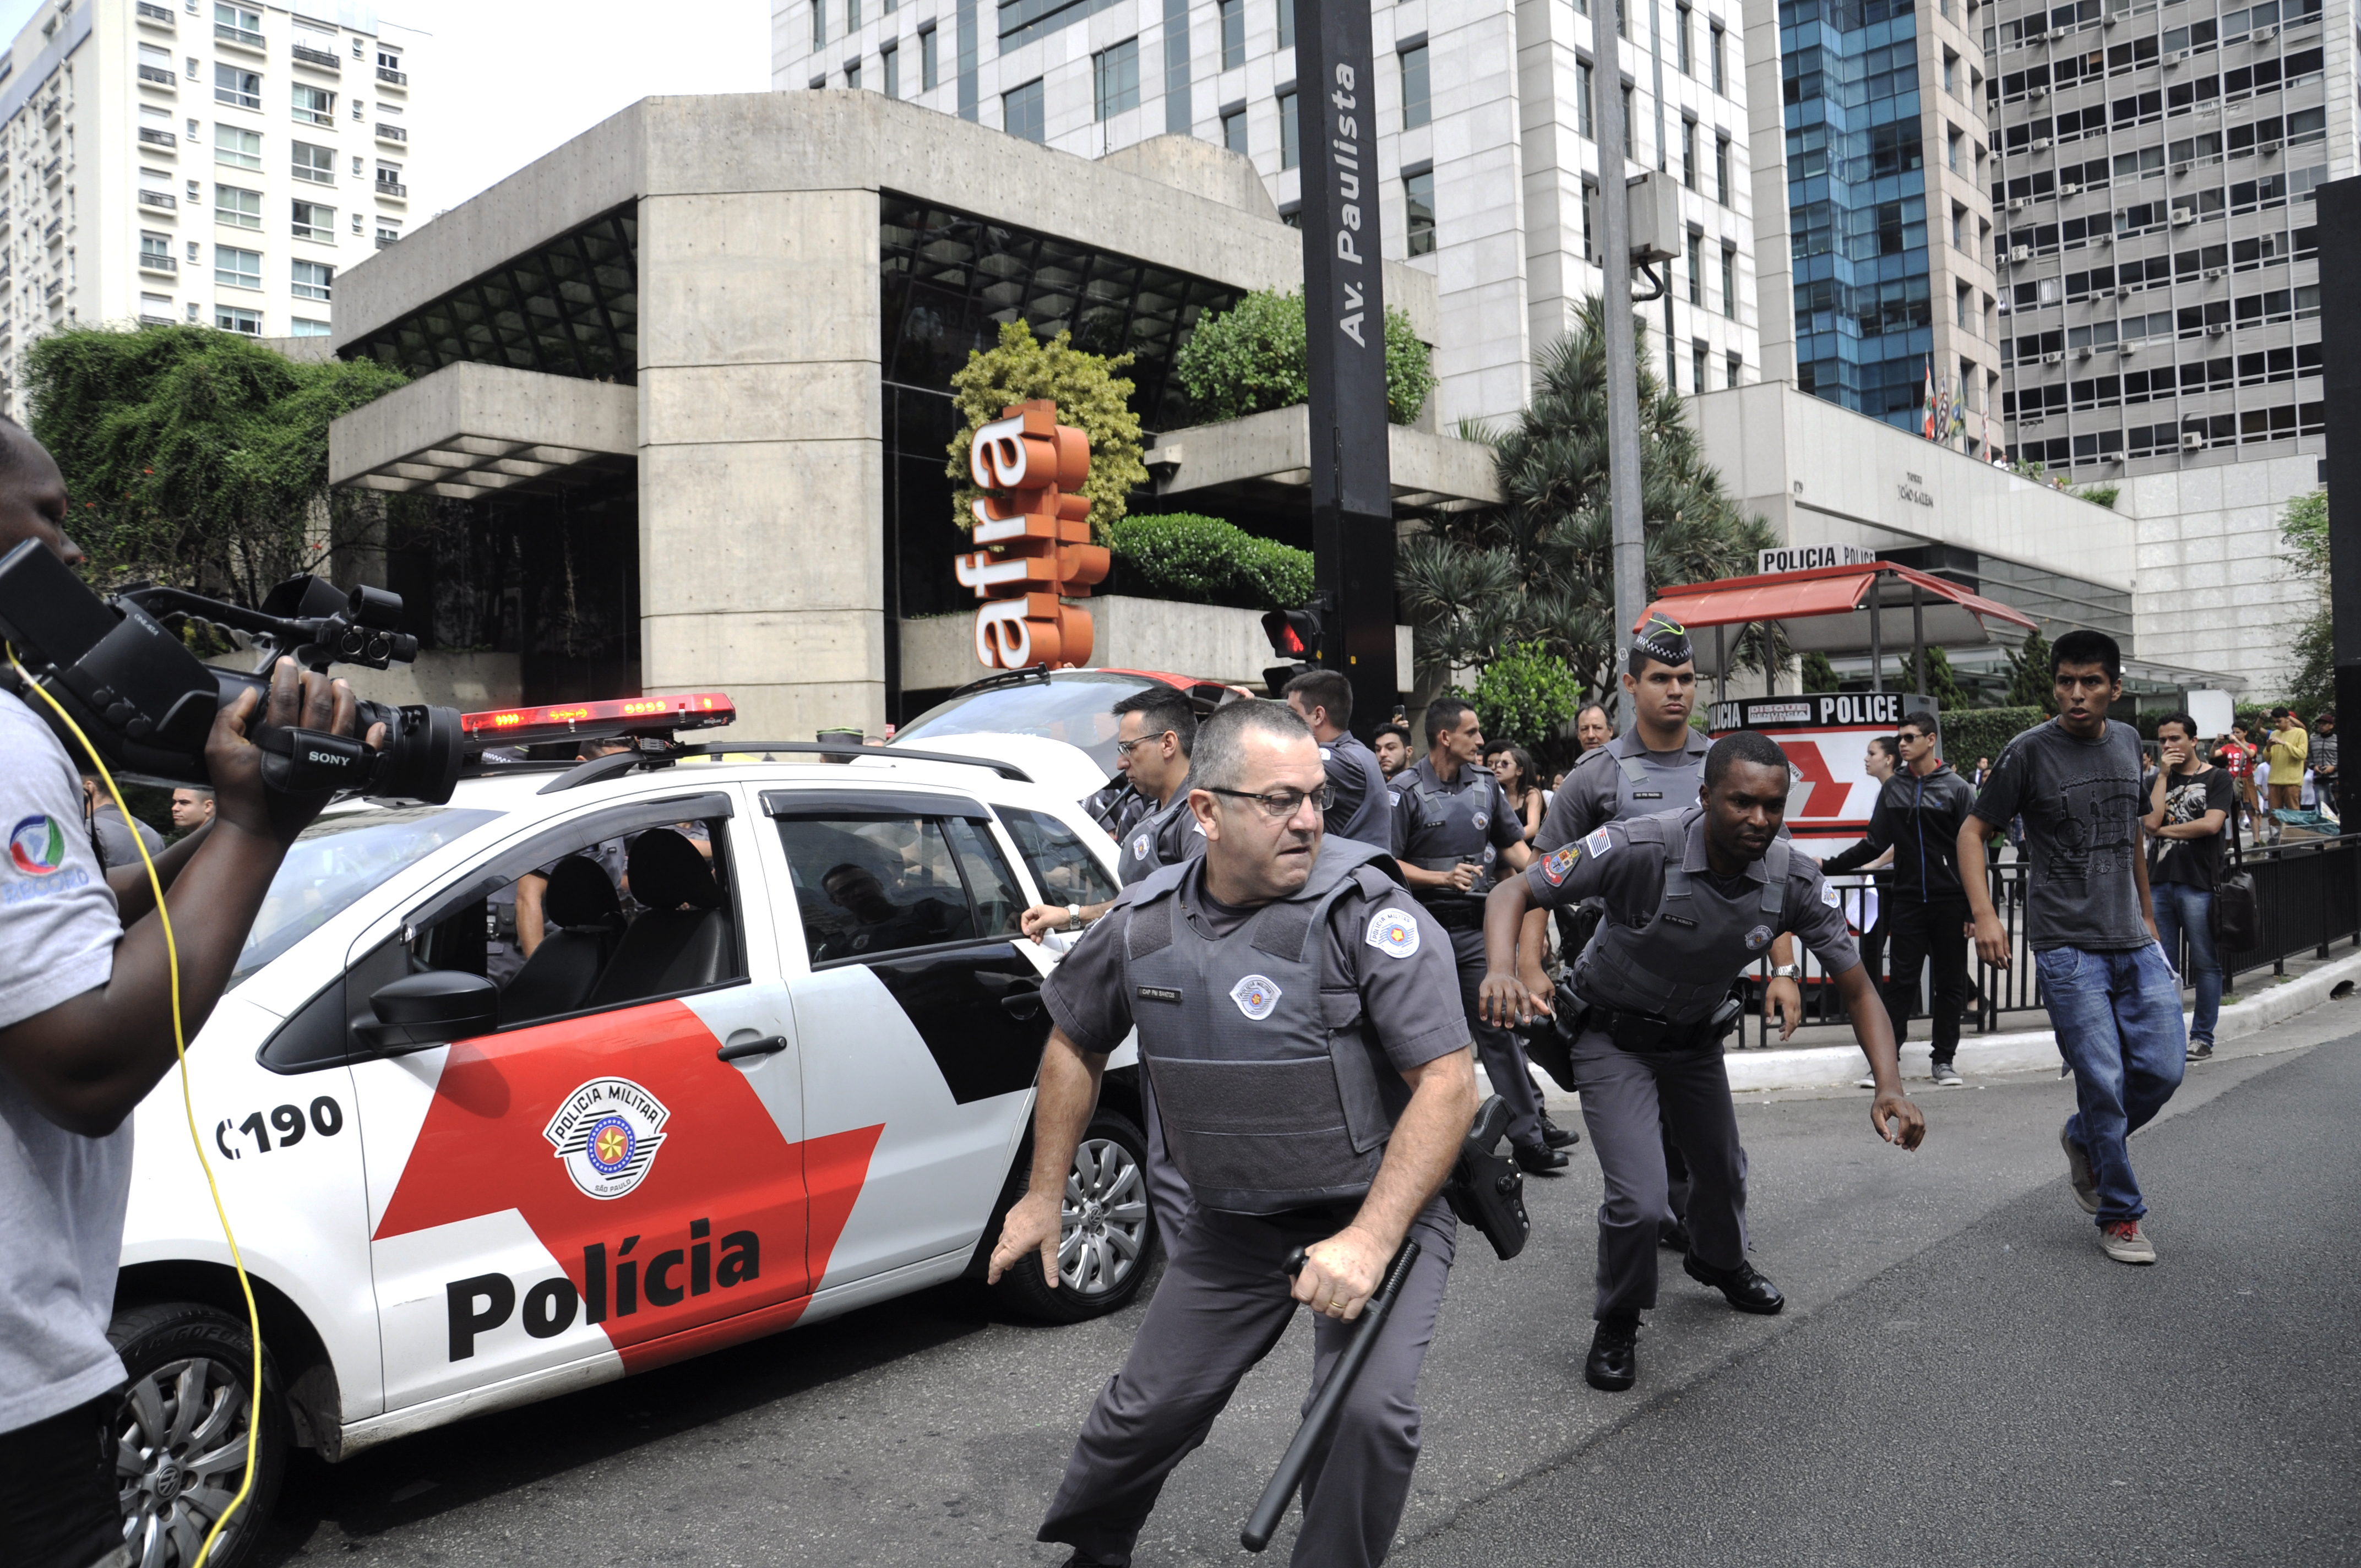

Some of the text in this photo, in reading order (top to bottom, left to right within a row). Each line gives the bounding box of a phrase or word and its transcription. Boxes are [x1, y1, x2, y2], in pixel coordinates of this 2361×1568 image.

[1331, 62, 1366, 348] Av. Paulista
[1764, 547, 1836, 572] POLICIA
[1750, 705, 1807, 714] DISQUE
[1820, 696, 1898, 724] POLICE
[309, 751, 350, 766] SONY
[2, 867, 89, 904] RECORD
[238, 1096, 343, 1153] 190
[554, 1085, 659, 1140] POLICIA MILITAR
[610, 1179, 632, 1192] PAULO
[446, 1217, 760, 1363] Polícia
